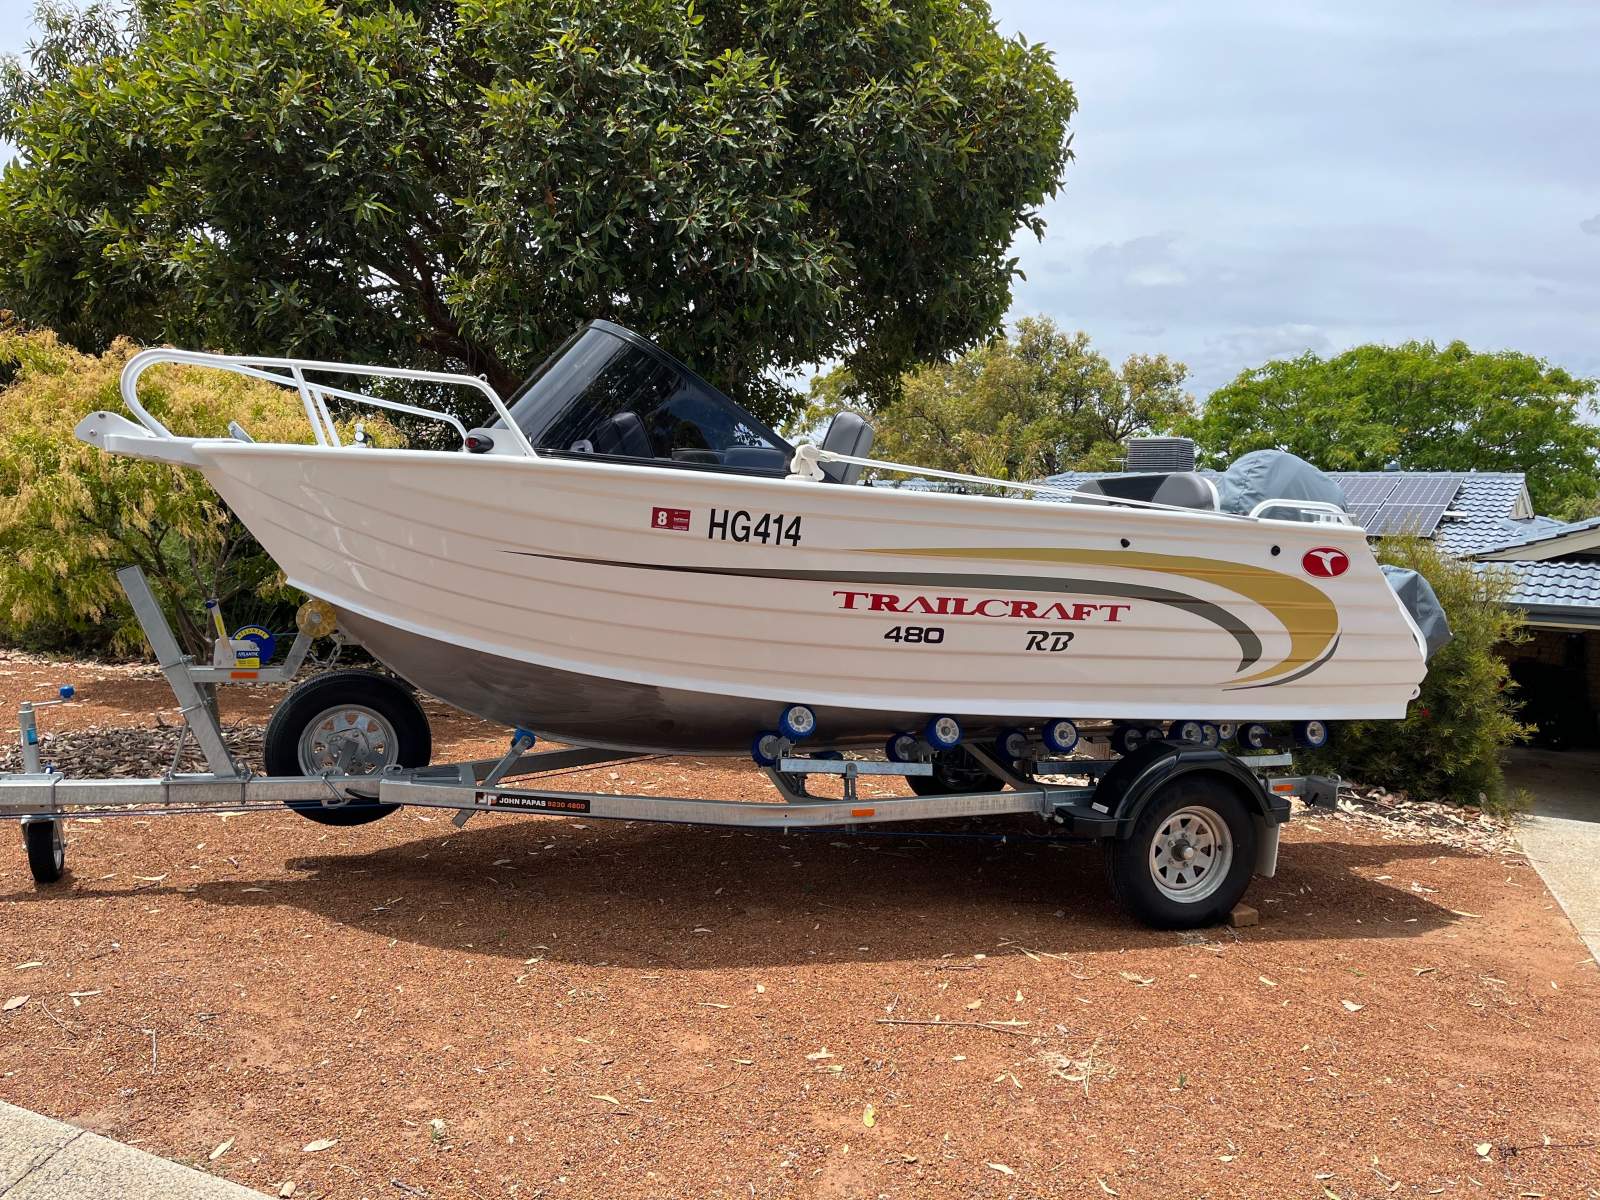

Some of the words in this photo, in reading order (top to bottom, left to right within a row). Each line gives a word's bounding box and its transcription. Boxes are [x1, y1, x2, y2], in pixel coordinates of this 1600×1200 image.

[657, 511, 668, 526] 8
[708, 508, 802, 547] HG414
[832, 590, 1131, 623] TRAILCRAFT
[883, 626, 945, 644] 480
[1025, 630, 1075, 652] RB
[499, 797, 520, 805] JOHN
[521, 799, 547, 807] PAPAS
